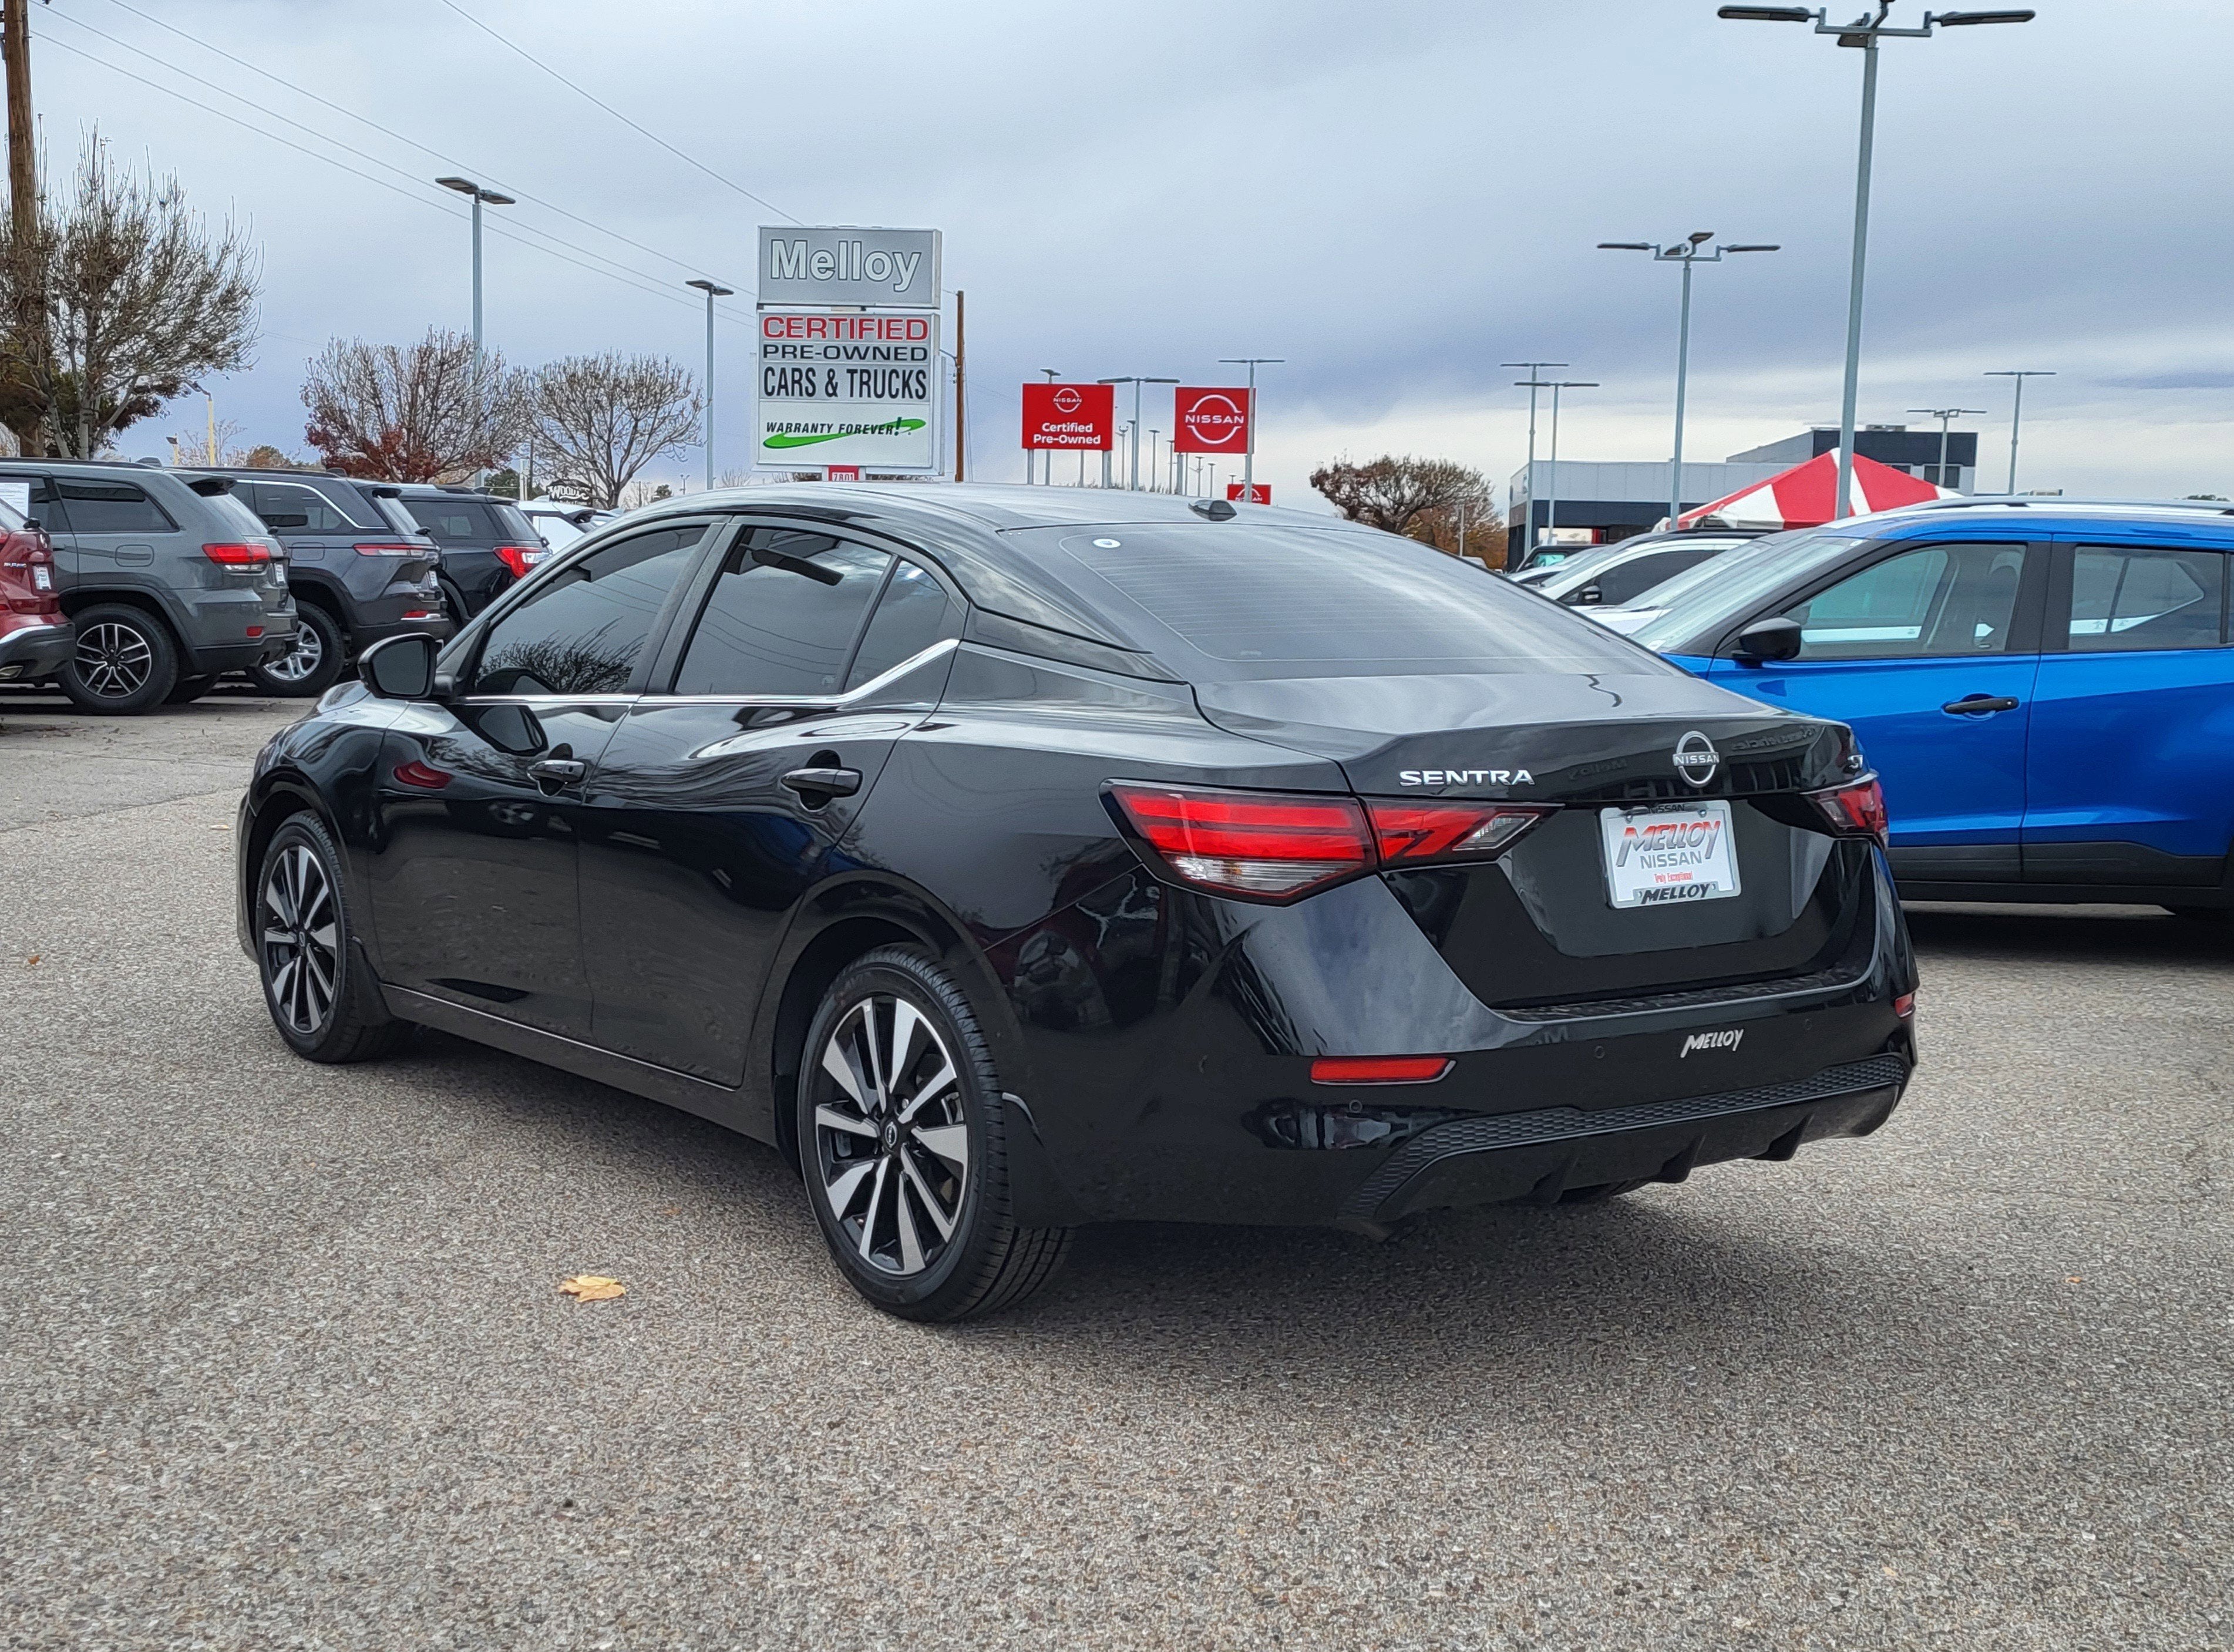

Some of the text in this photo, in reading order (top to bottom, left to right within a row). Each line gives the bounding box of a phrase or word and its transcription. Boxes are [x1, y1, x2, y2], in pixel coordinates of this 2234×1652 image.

[770, 239, 922, 292] Melloy
[763, 316, 928, 341] CERTIFIED
[763, 344, 928, 361] PRE-OWNED
[763, 366, 927, 399] CARS & TRUCKS
[766, 417, 902, 436] WARRANTY FOREVER!
[1042, 422, 1093, 433] Certified
[1185, 414, 1244, 424] NISSAN
[1033, 433, 1101, 445] Pre-Owned
[1675, 754, 1720, 764] NISSAN
[1399, 769, 1536, 786] SENTRA
[1616, 820, 1721, 867] MELLOY
[1640, 851, 1703, 869] NISSAN
[1641, 884, 1710, 904] MELLOY
[1680, 1029, 1744, 1058] MELLOY
